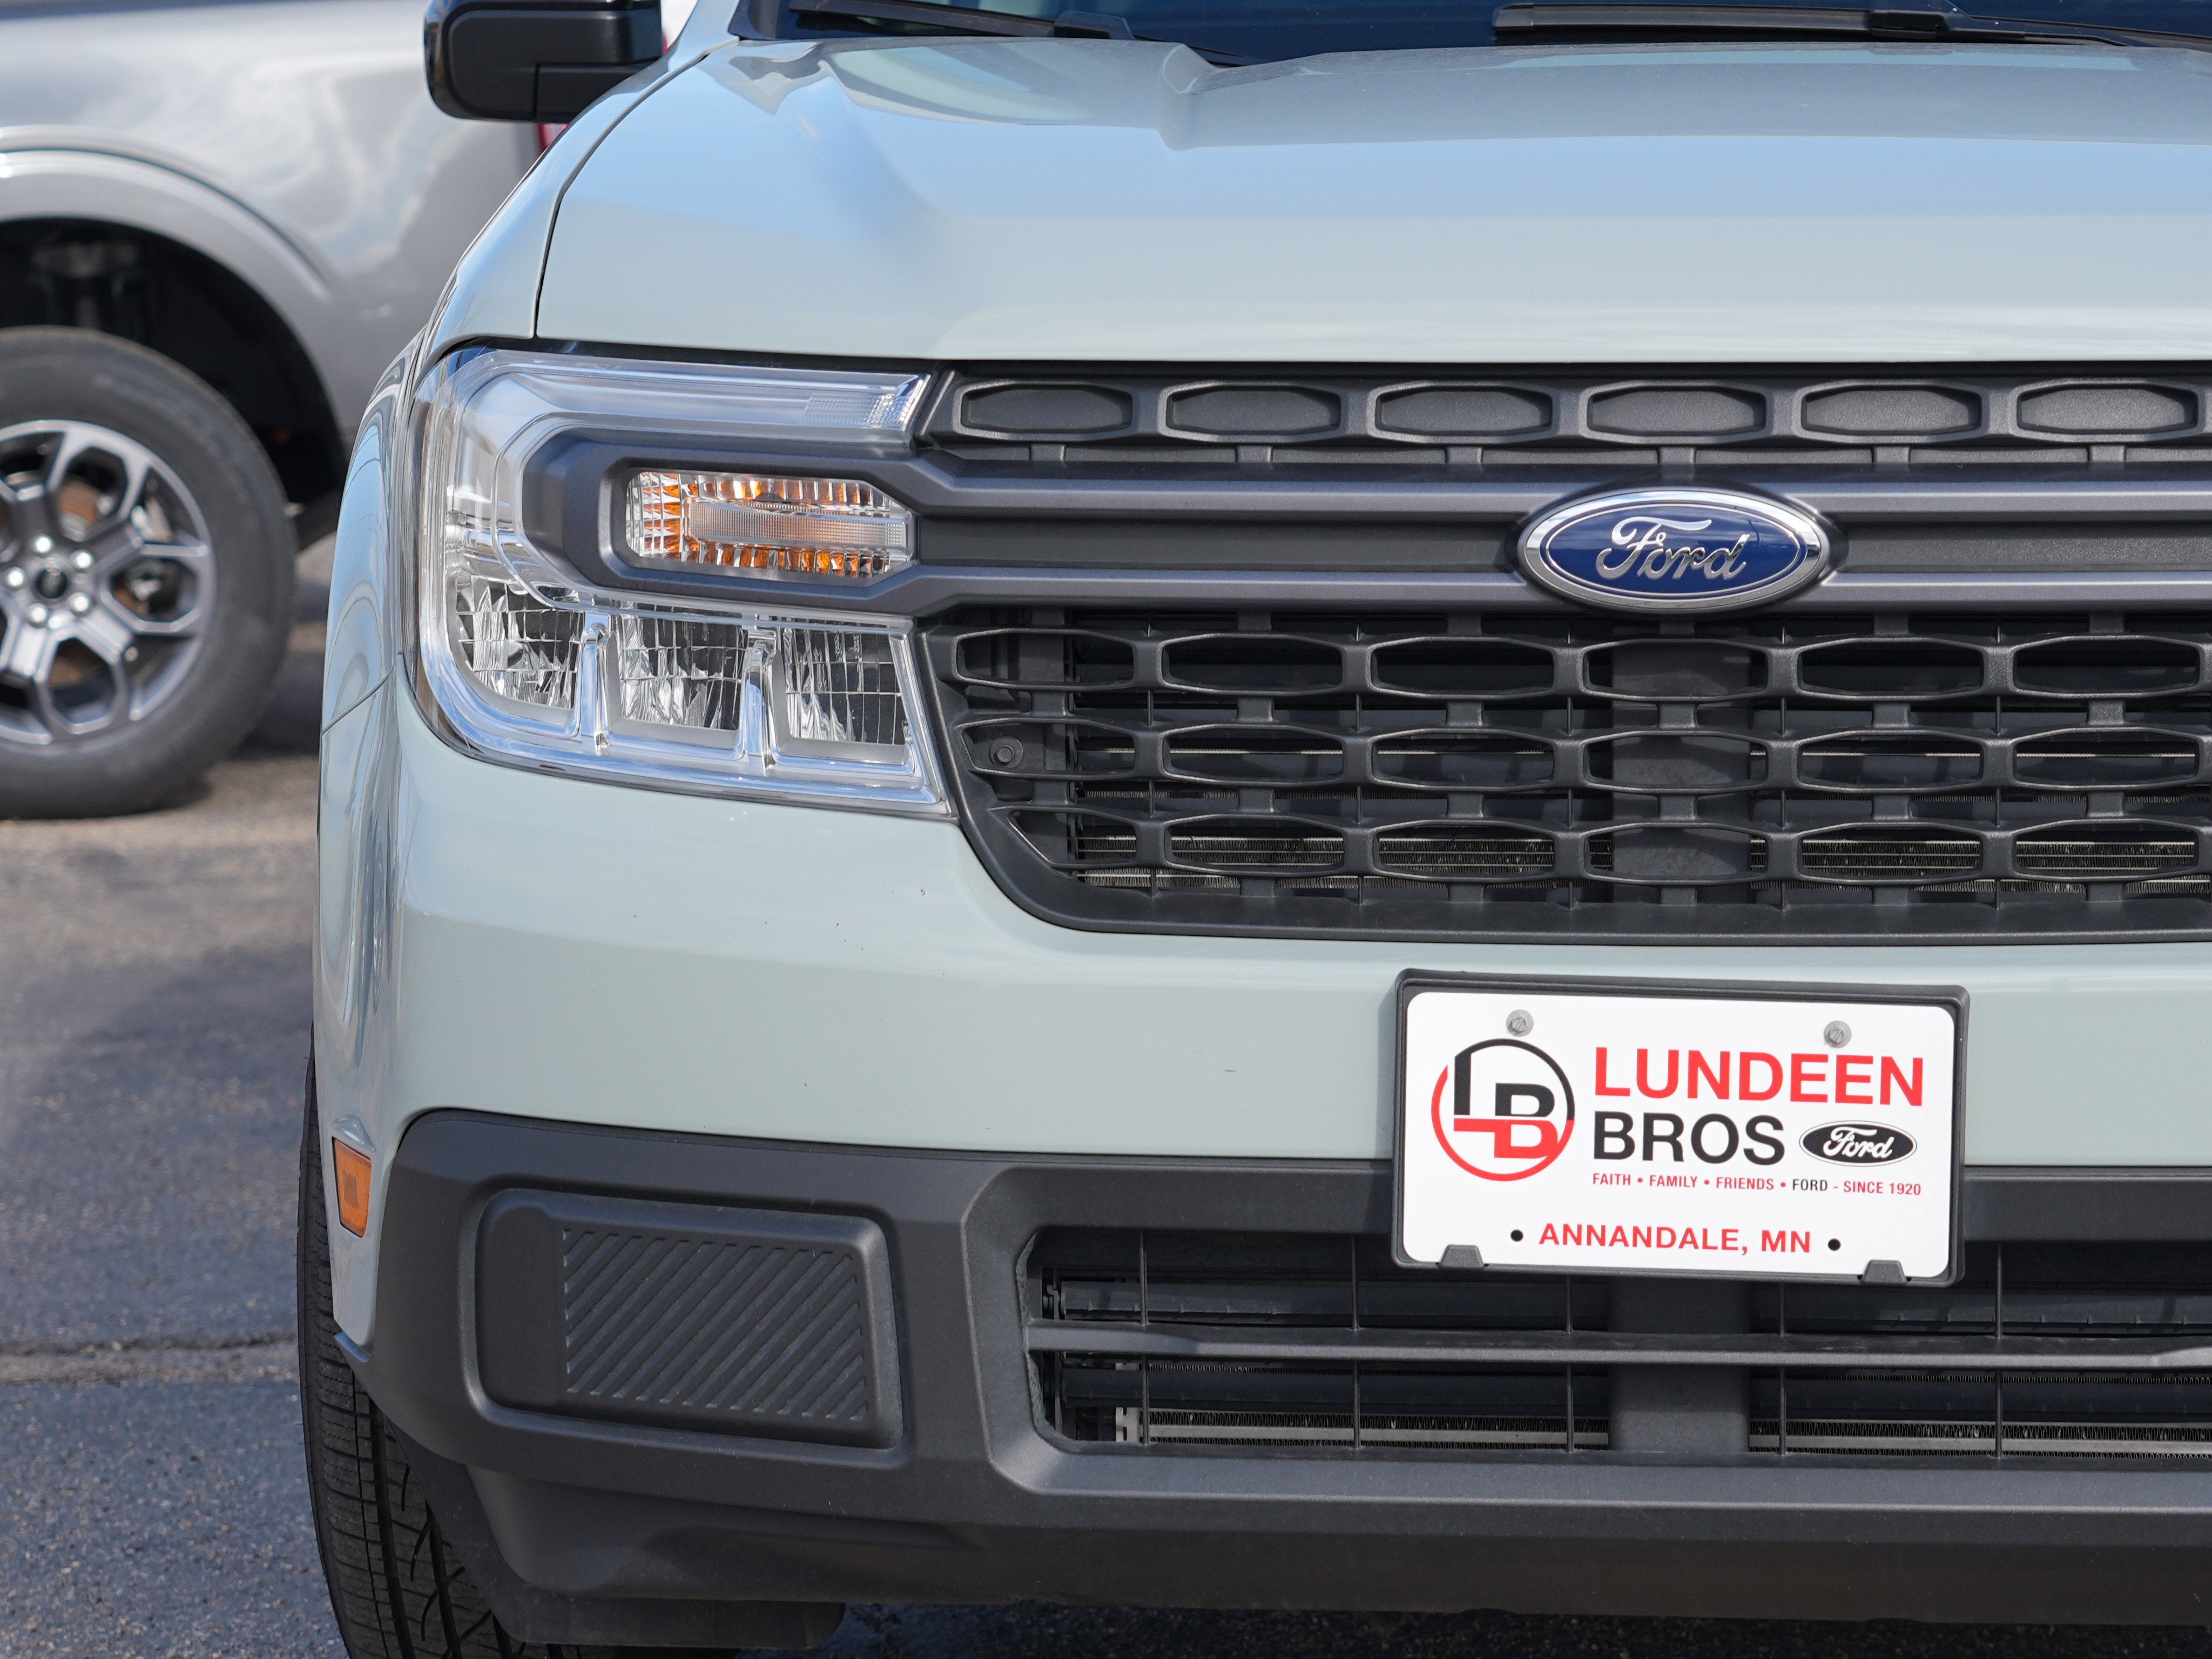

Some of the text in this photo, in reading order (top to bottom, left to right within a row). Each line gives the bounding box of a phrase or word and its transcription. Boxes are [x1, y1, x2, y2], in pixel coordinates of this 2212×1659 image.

[1596, 516, 1751, 581] Ford
[1595, 1047, 1923, 1107] LUNDEEN
[1594, 1111, 1785, 1166] BROS
[1823, 1126, 1895, 1159] Ford
[1593, 1173, 1922, 1196] FAITH FAMILY FRIENDS FORD SINCE 1920
[1539, 1223, 1811, 1256] ANNANDALE, MN
